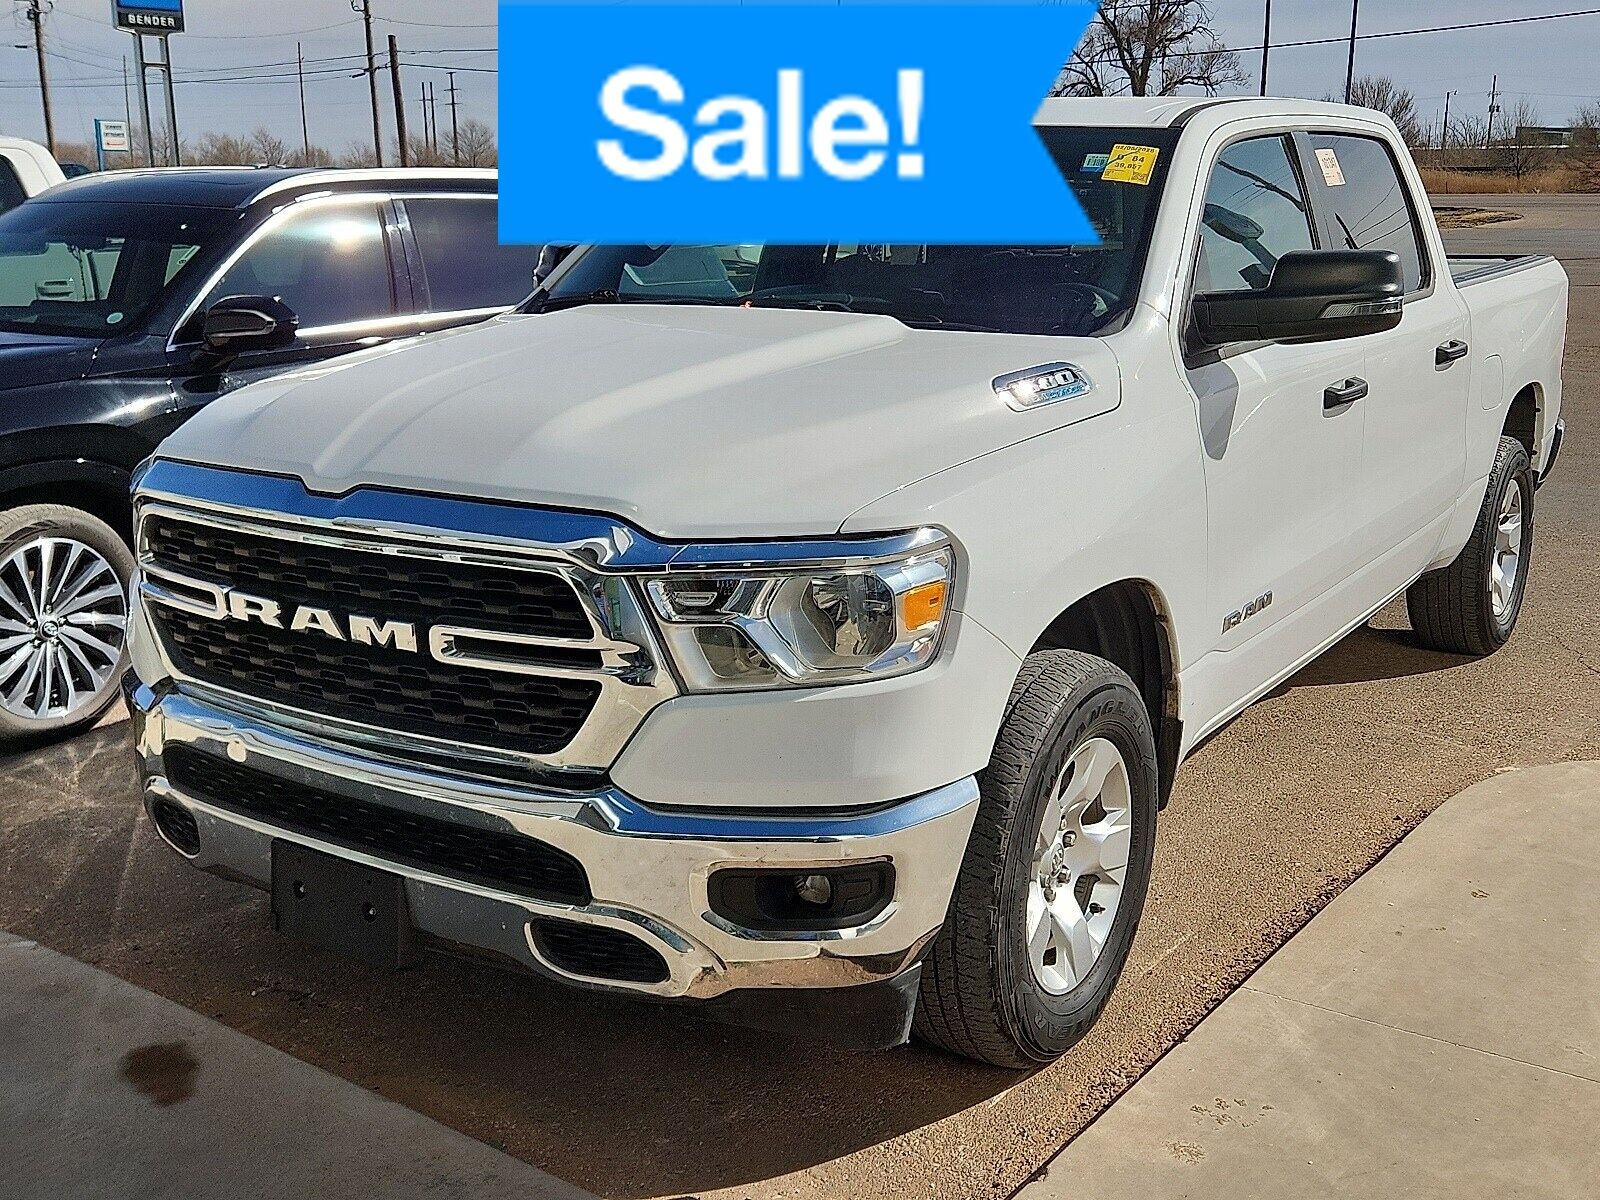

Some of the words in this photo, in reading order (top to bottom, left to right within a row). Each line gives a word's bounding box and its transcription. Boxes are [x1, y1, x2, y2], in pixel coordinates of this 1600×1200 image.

[127, 14, 176, 28] BENDER
[228, 590, 418, 653] RAM
[1220, 590, 1273, 635] RAM
